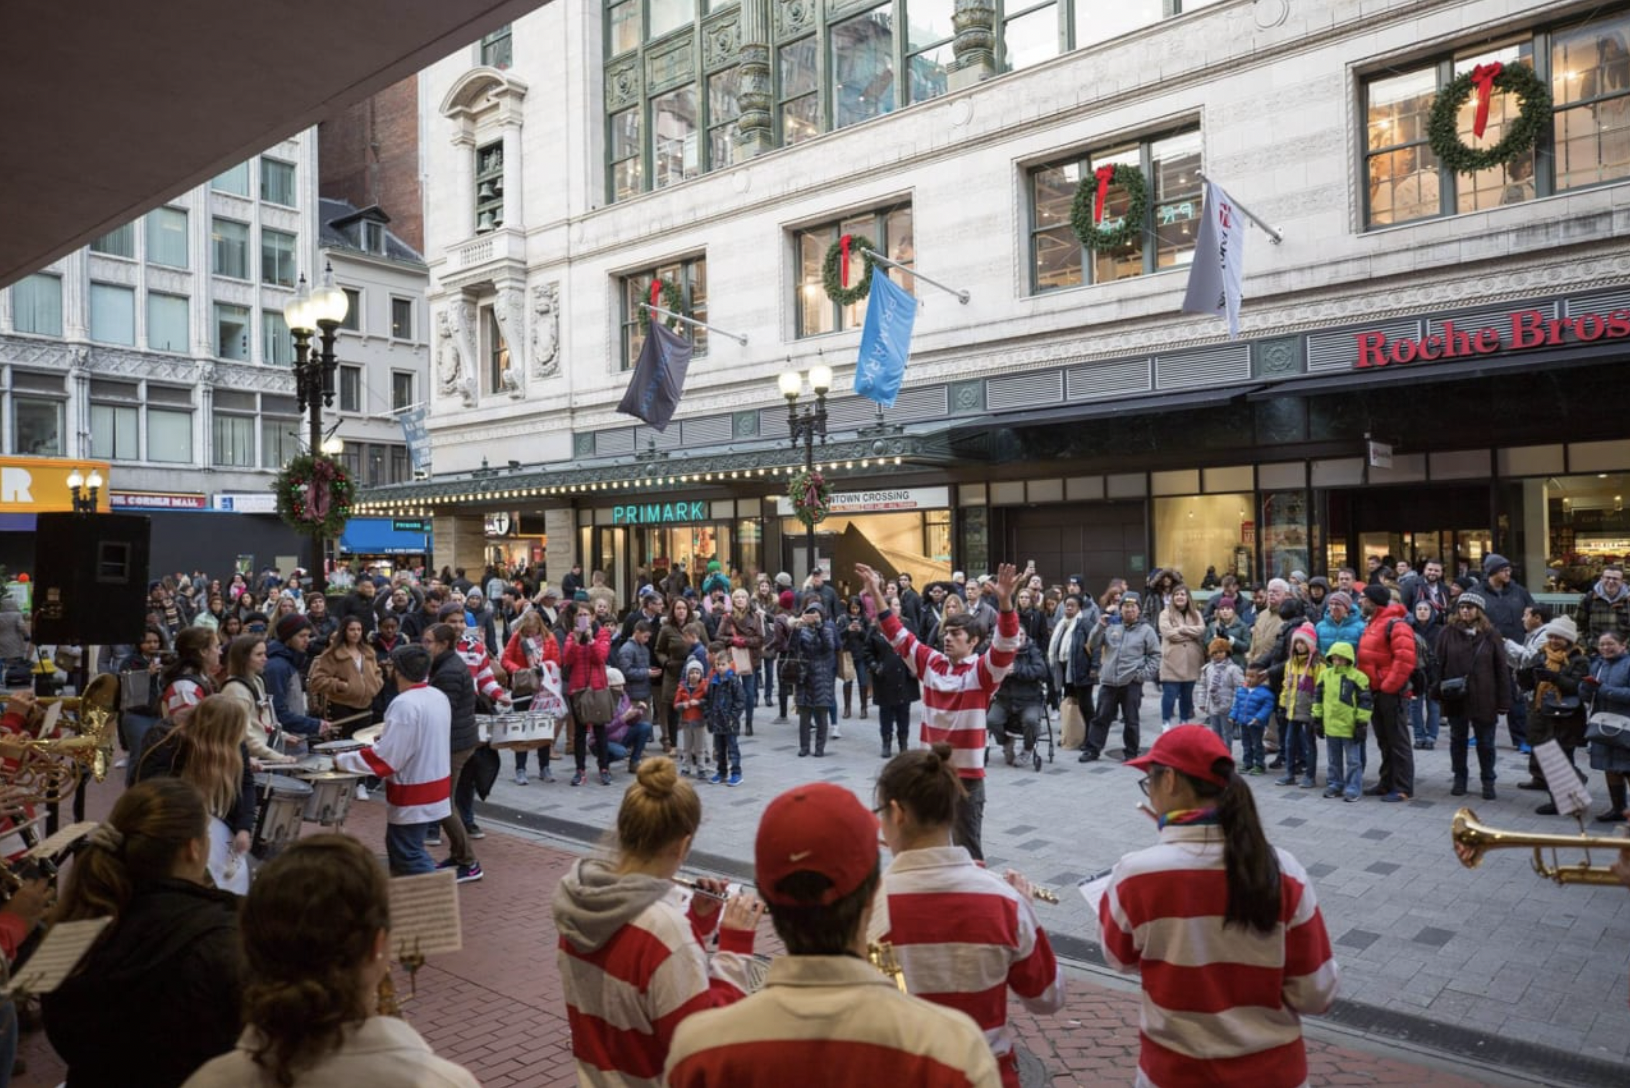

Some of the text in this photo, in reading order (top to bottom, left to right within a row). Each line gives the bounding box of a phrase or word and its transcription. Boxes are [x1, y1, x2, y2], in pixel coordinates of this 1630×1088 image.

[861, 296, 896, 389] PRIMARK
[1352, 321, 1500, 368] Roche
[1, 467, 34, 502] R
[830, 491, 909, 503] NTOWN CROSSING
[127, 496, 169, 507] CORNER
[171, 497, 198, 508] MALL
[613, 501, 704, 524] PRIMARK
